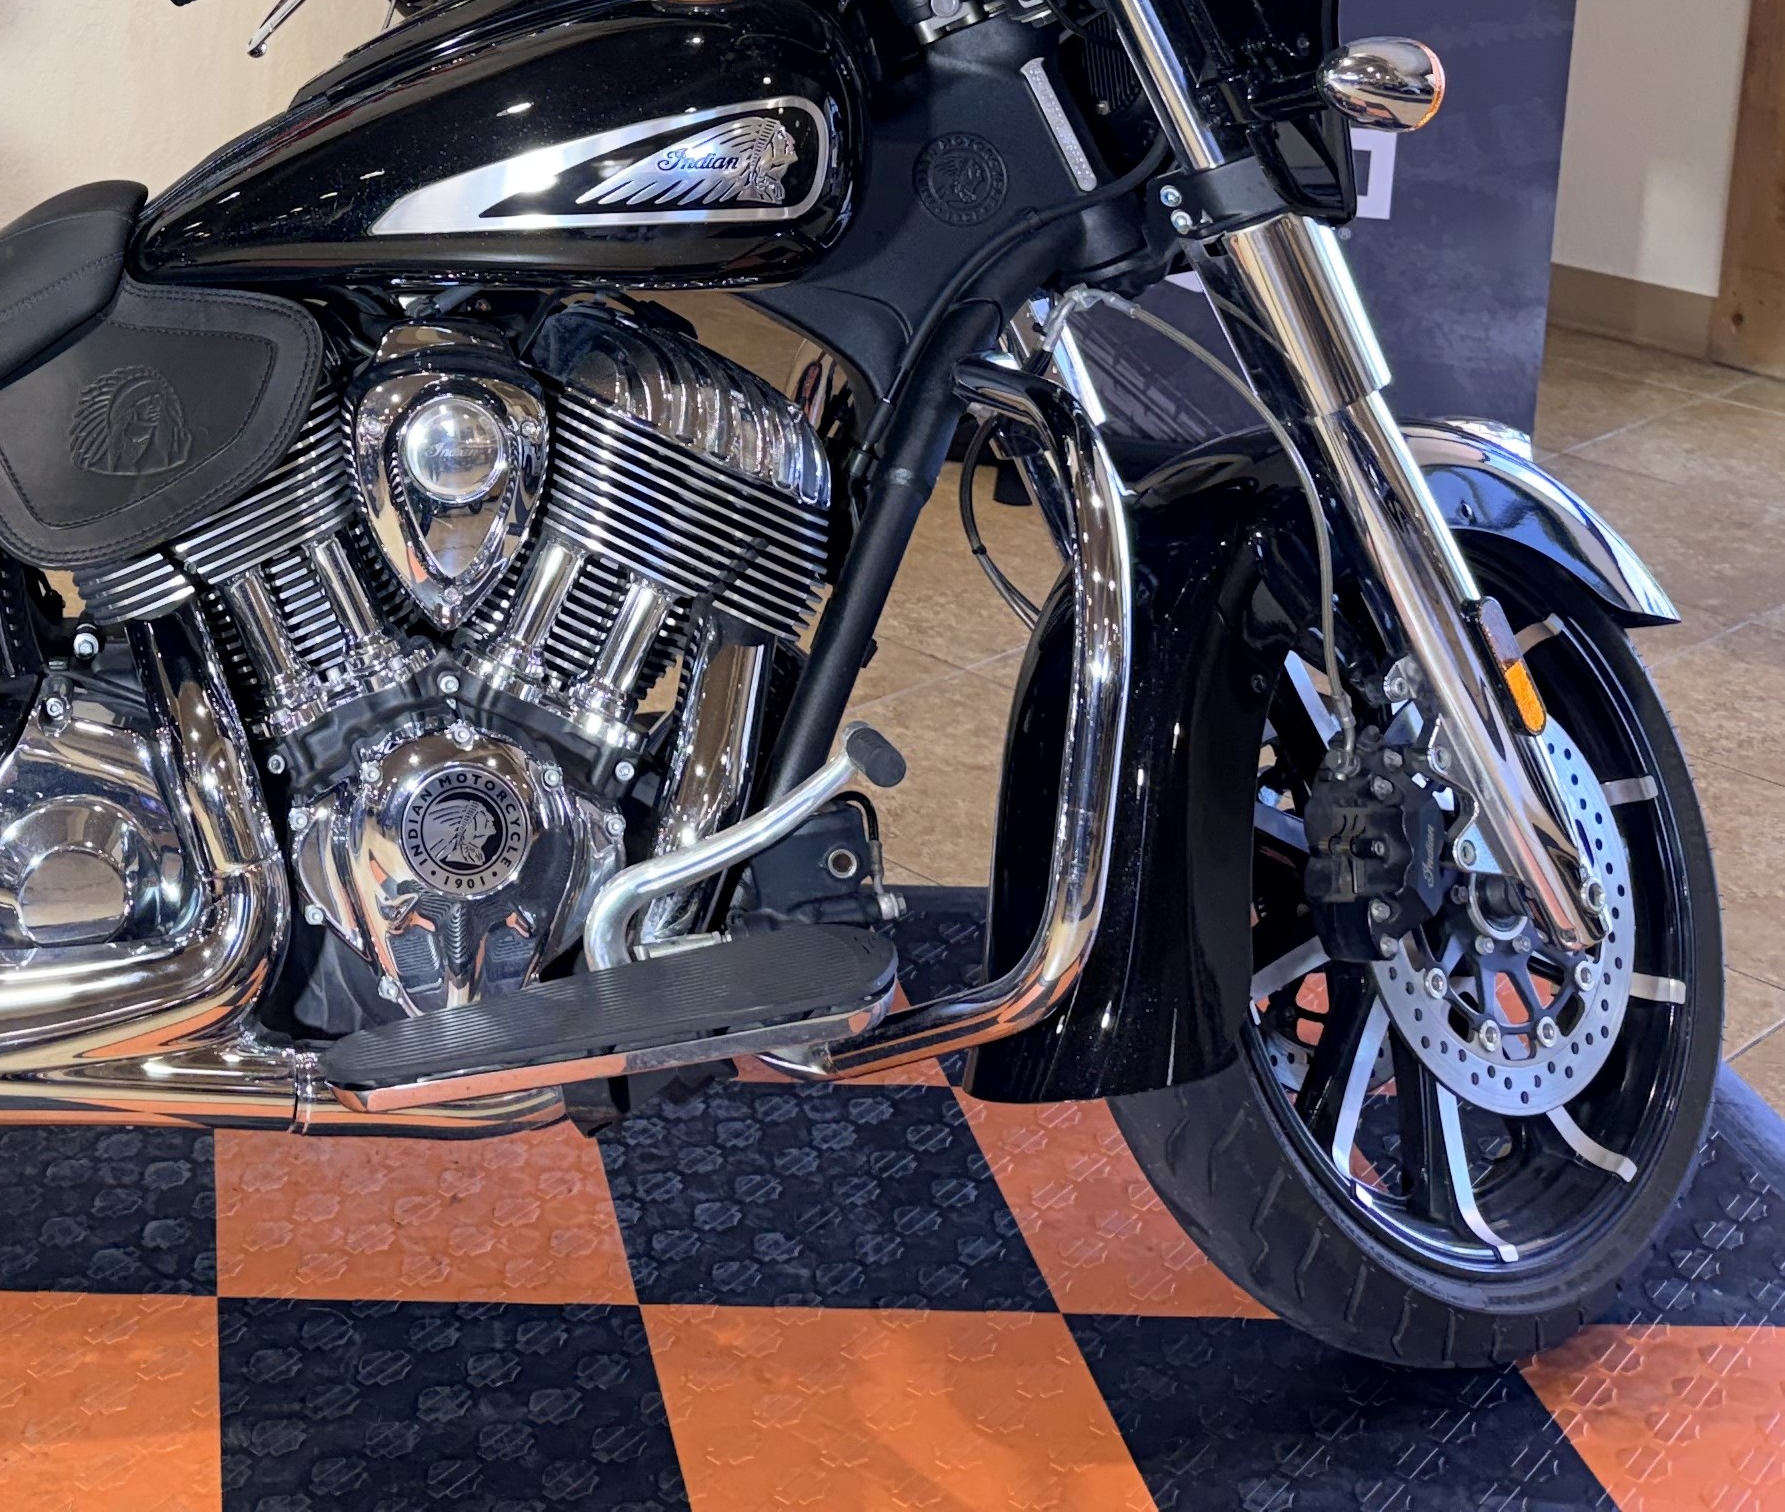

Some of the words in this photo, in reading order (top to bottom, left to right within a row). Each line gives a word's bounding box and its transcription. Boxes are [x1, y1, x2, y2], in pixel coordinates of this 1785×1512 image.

[656, 147, 740, 172] Indian
[408, 789, 433, 866] INDIAN
[438, 773, 521, 868] MOTORCYCLE
[444, 875, 486, 888] 1901
